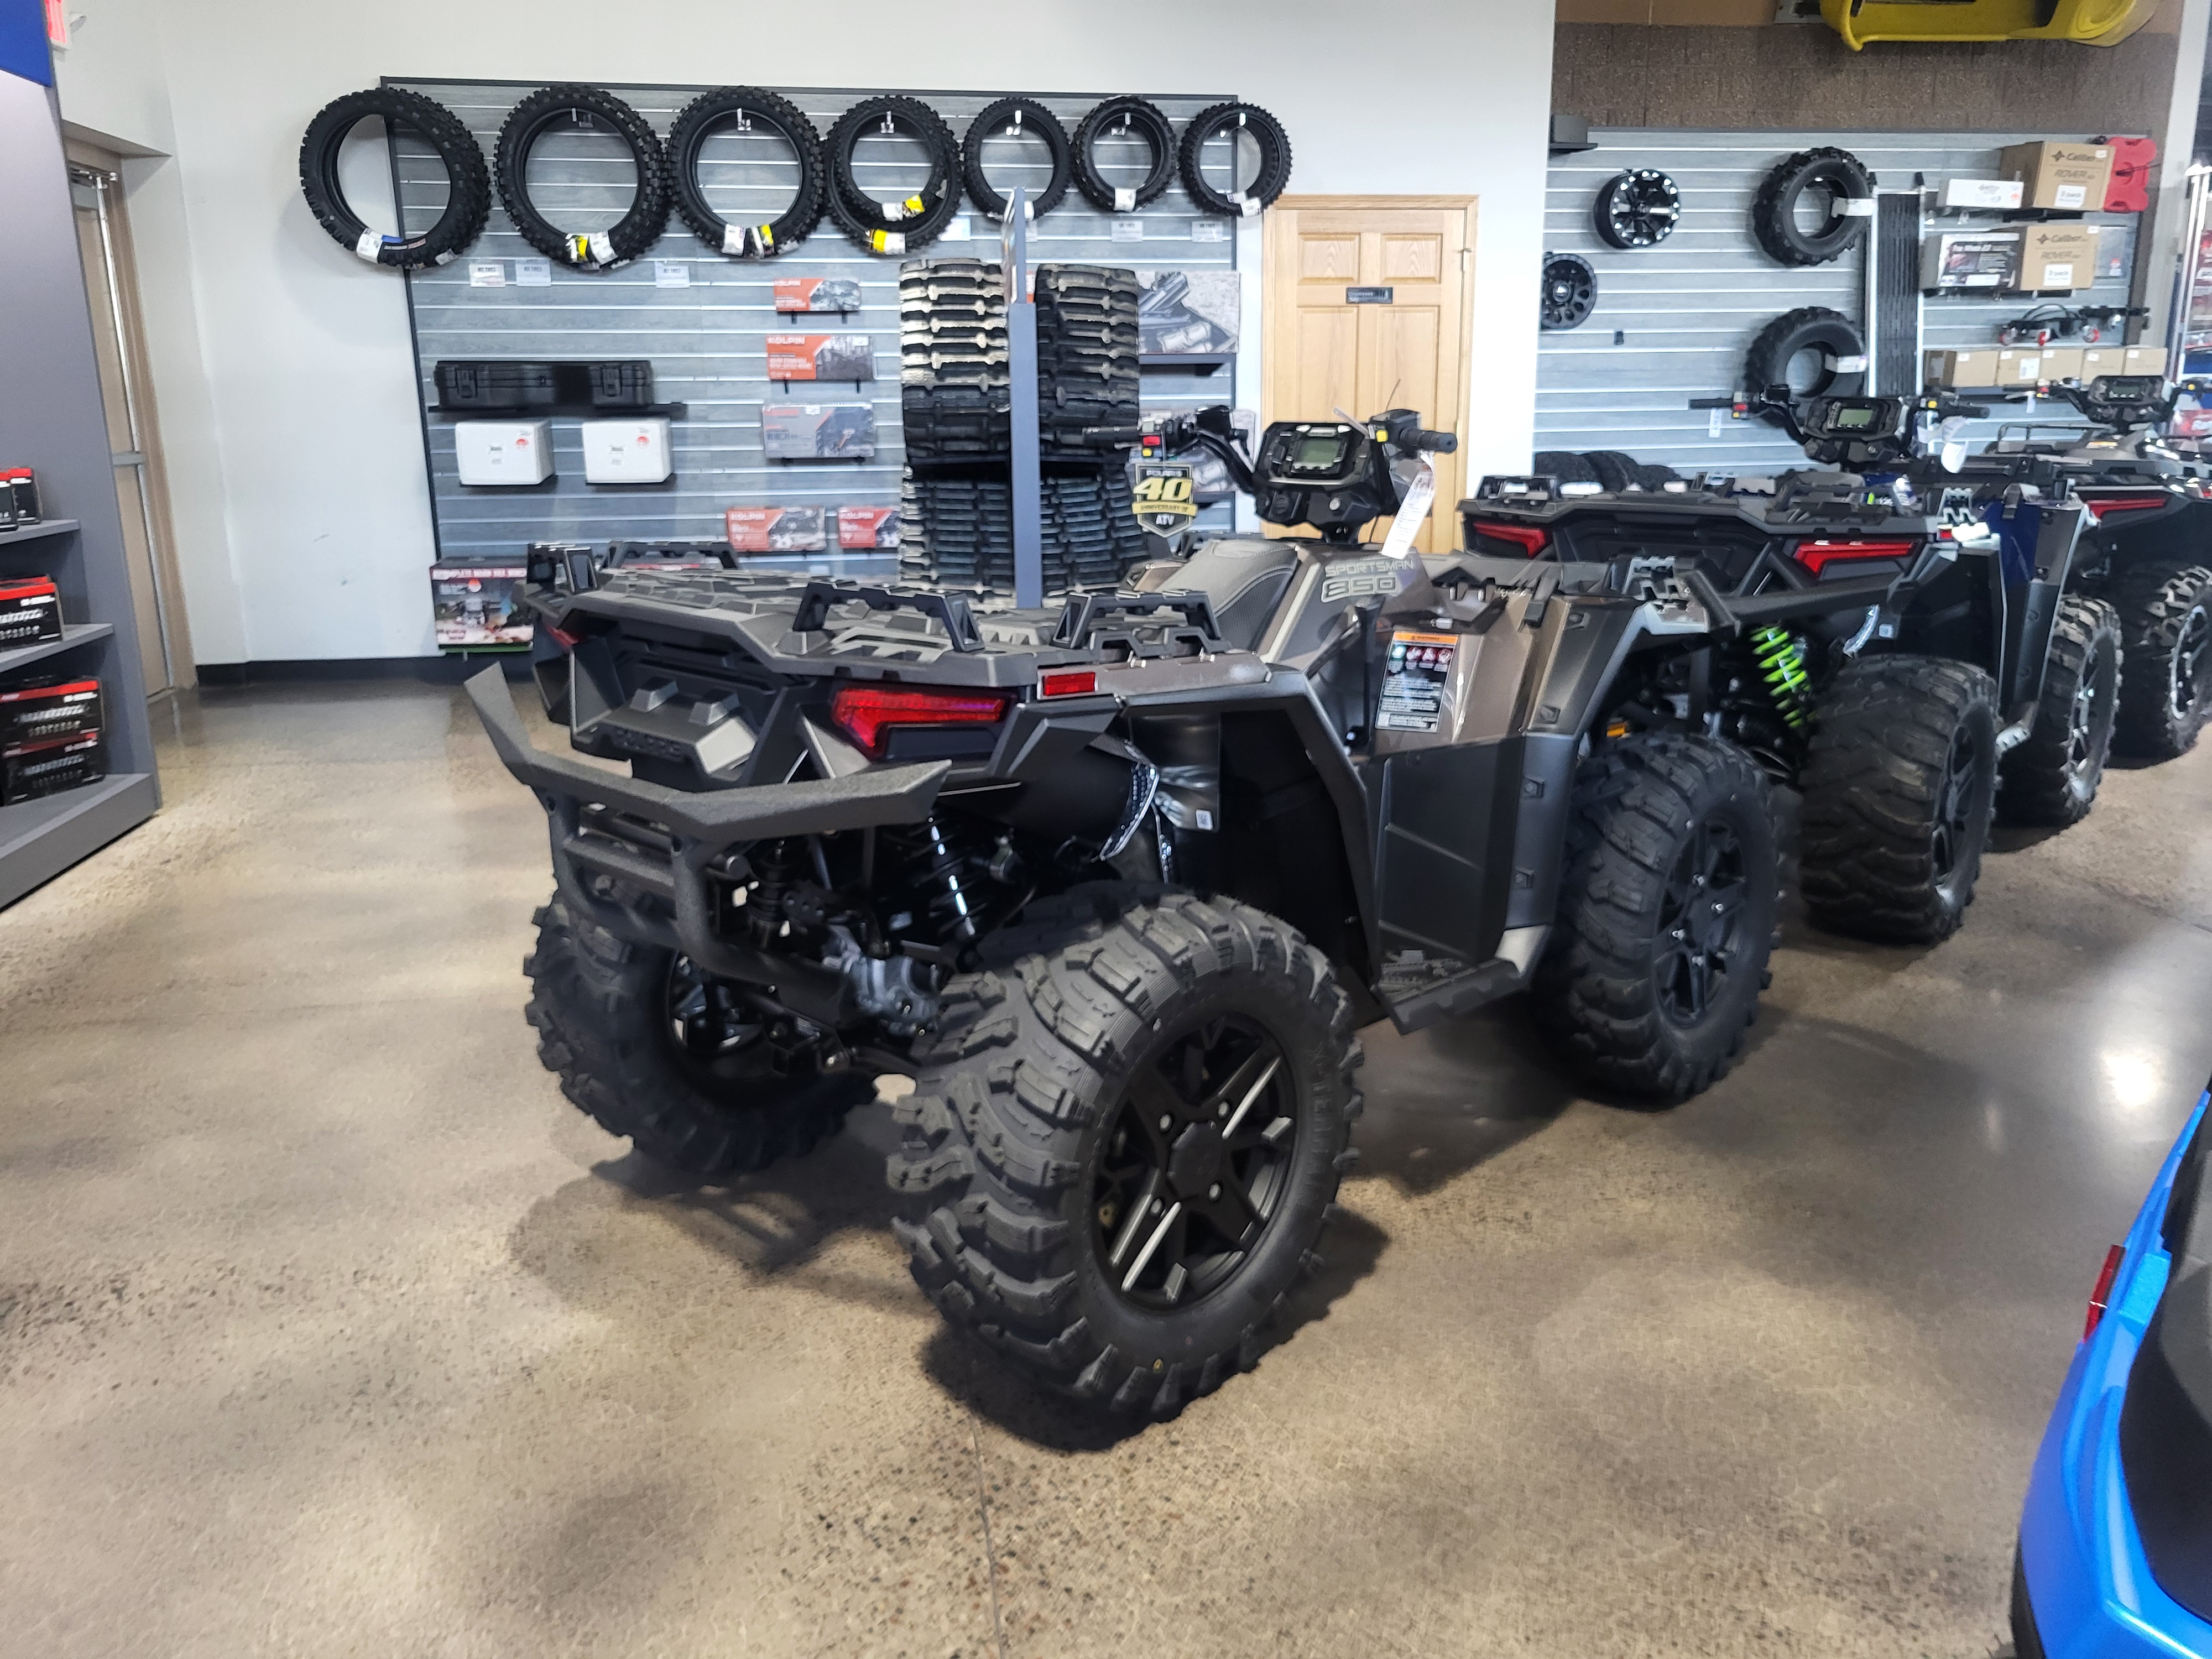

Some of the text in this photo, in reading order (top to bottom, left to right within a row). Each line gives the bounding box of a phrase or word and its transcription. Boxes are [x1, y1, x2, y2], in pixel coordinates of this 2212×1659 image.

[767, 336, 805, 345] KOLPIN
[1133, 476, 1193, 501] 40
[1155, 514, 1175, 526] ATV
[1324, 558, 1415, 577] SPORTSMAN
[1321, 574, 1398, 603] 850
